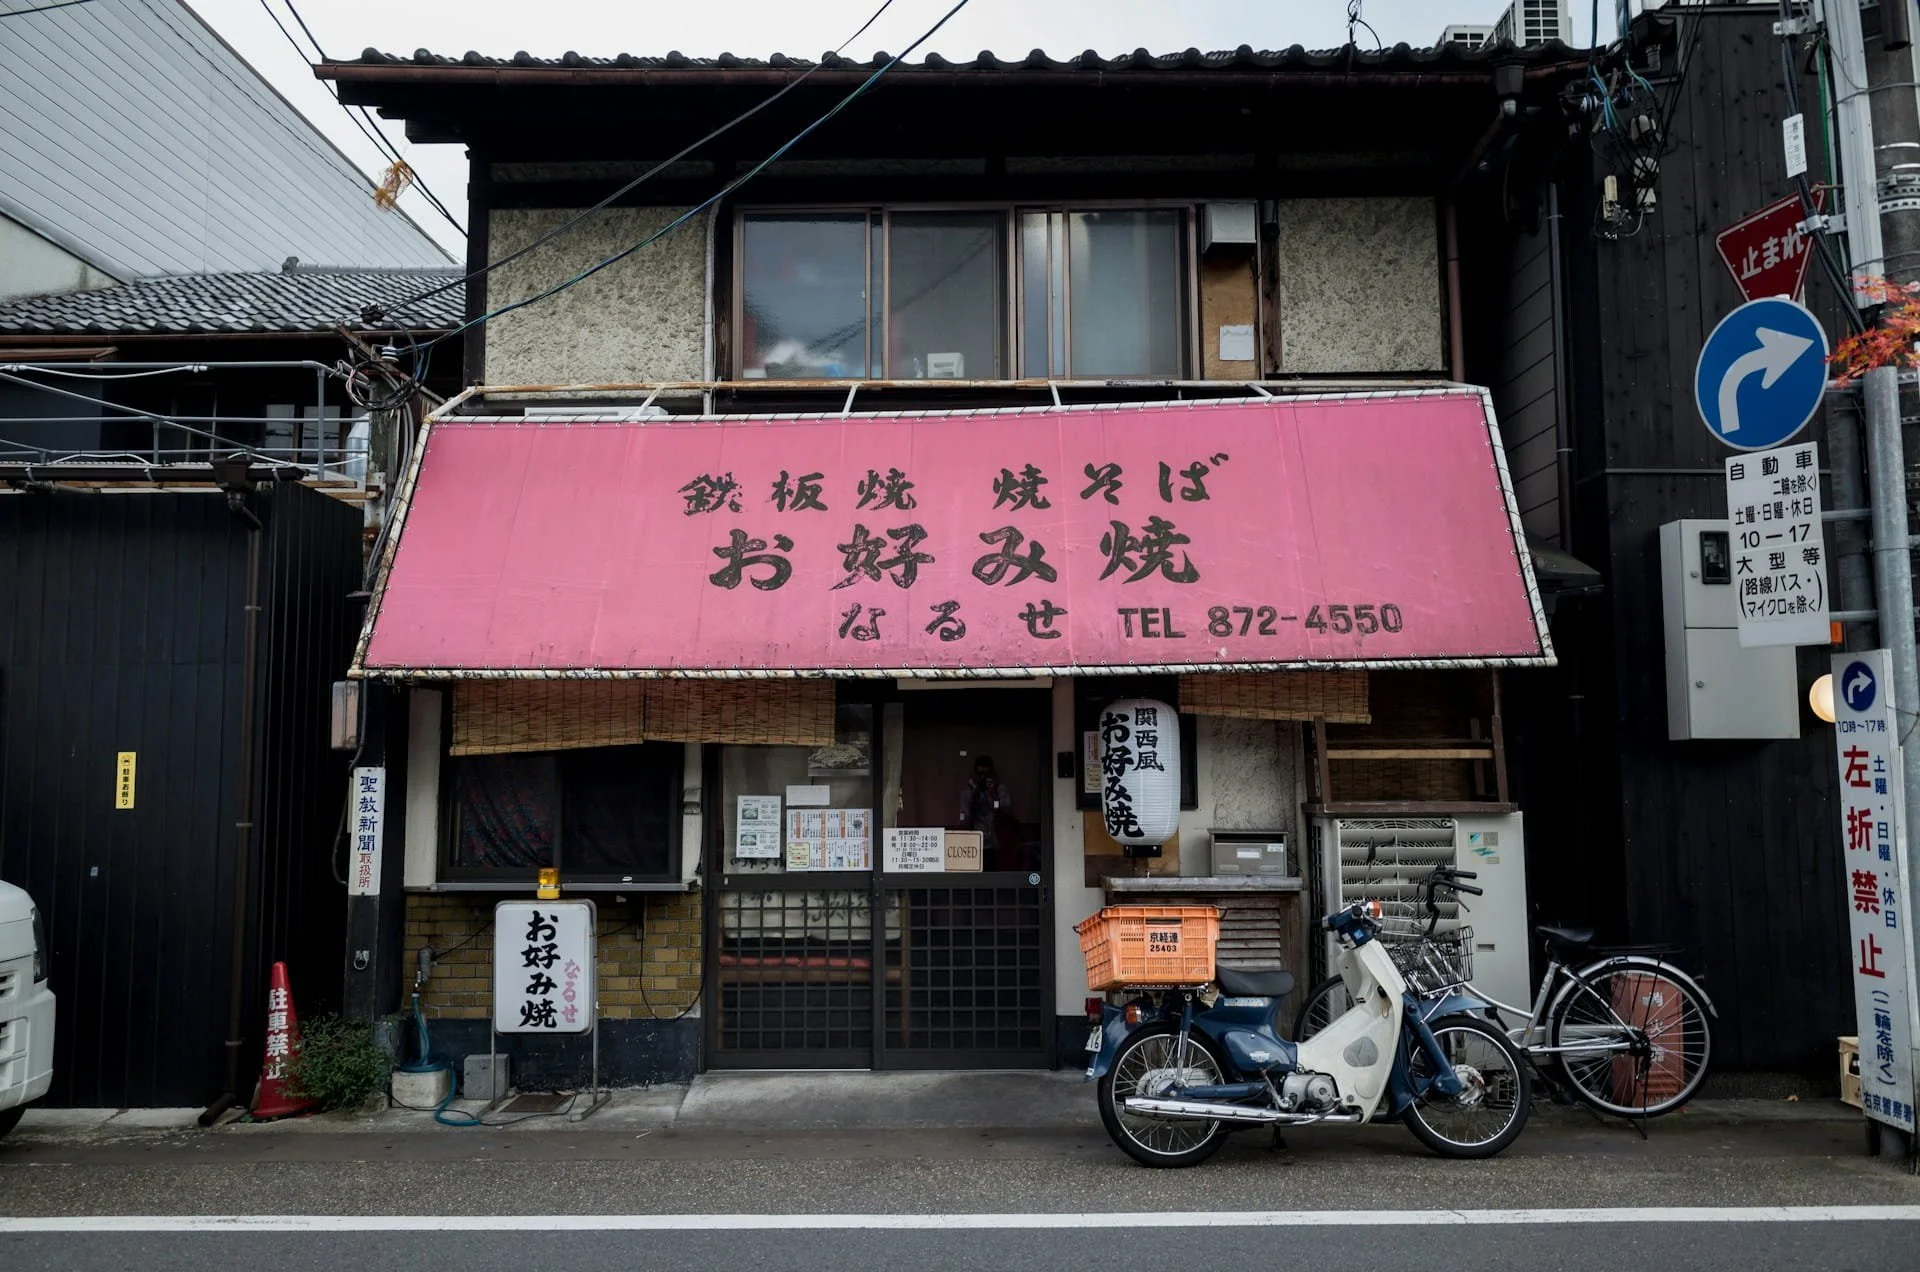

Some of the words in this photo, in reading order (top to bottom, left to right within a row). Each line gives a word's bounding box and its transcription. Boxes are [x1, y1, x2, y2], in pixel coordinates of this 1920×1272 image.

[1740, 227, 1804, 281] 止まれ
[992, 452, 1229, 512] 焼そば
[1730, 450, 1813, 481] 自動車
[1735, 496, 1813, 526] 土曜・日曜・休日
[709, 514, 1201, 591] お好み焼
[1736, 546, 1821, 575] 大型等
[838, 599, 1069, 642] なるせ
[1117, 607, 1187, 639] TEL
[1207, 603, 1404, 638] 872-4550
[1132, 707, 1165, 772] 関西風
[1101, 712, 1145, 838] お好み焼
[357, 776, 380, 852] 聖教新聞
[1873, 755, 1898, 930] 土曜・日曜・休日
[358, 853, 373, 889] 取扱所
[947, 846, 978, 859] CLOSED
[1842, 744, 1887, 979] 左折禁止
[518, 910, 561, 1029] お好み焼
[1150, 944, 1178, 953] 25403
[561, 958, 581, 1024] なるせ
[265, 987, 289, 1080] 駐車禁止
[1863, 1090, 1913, 1124] 右京警察署
